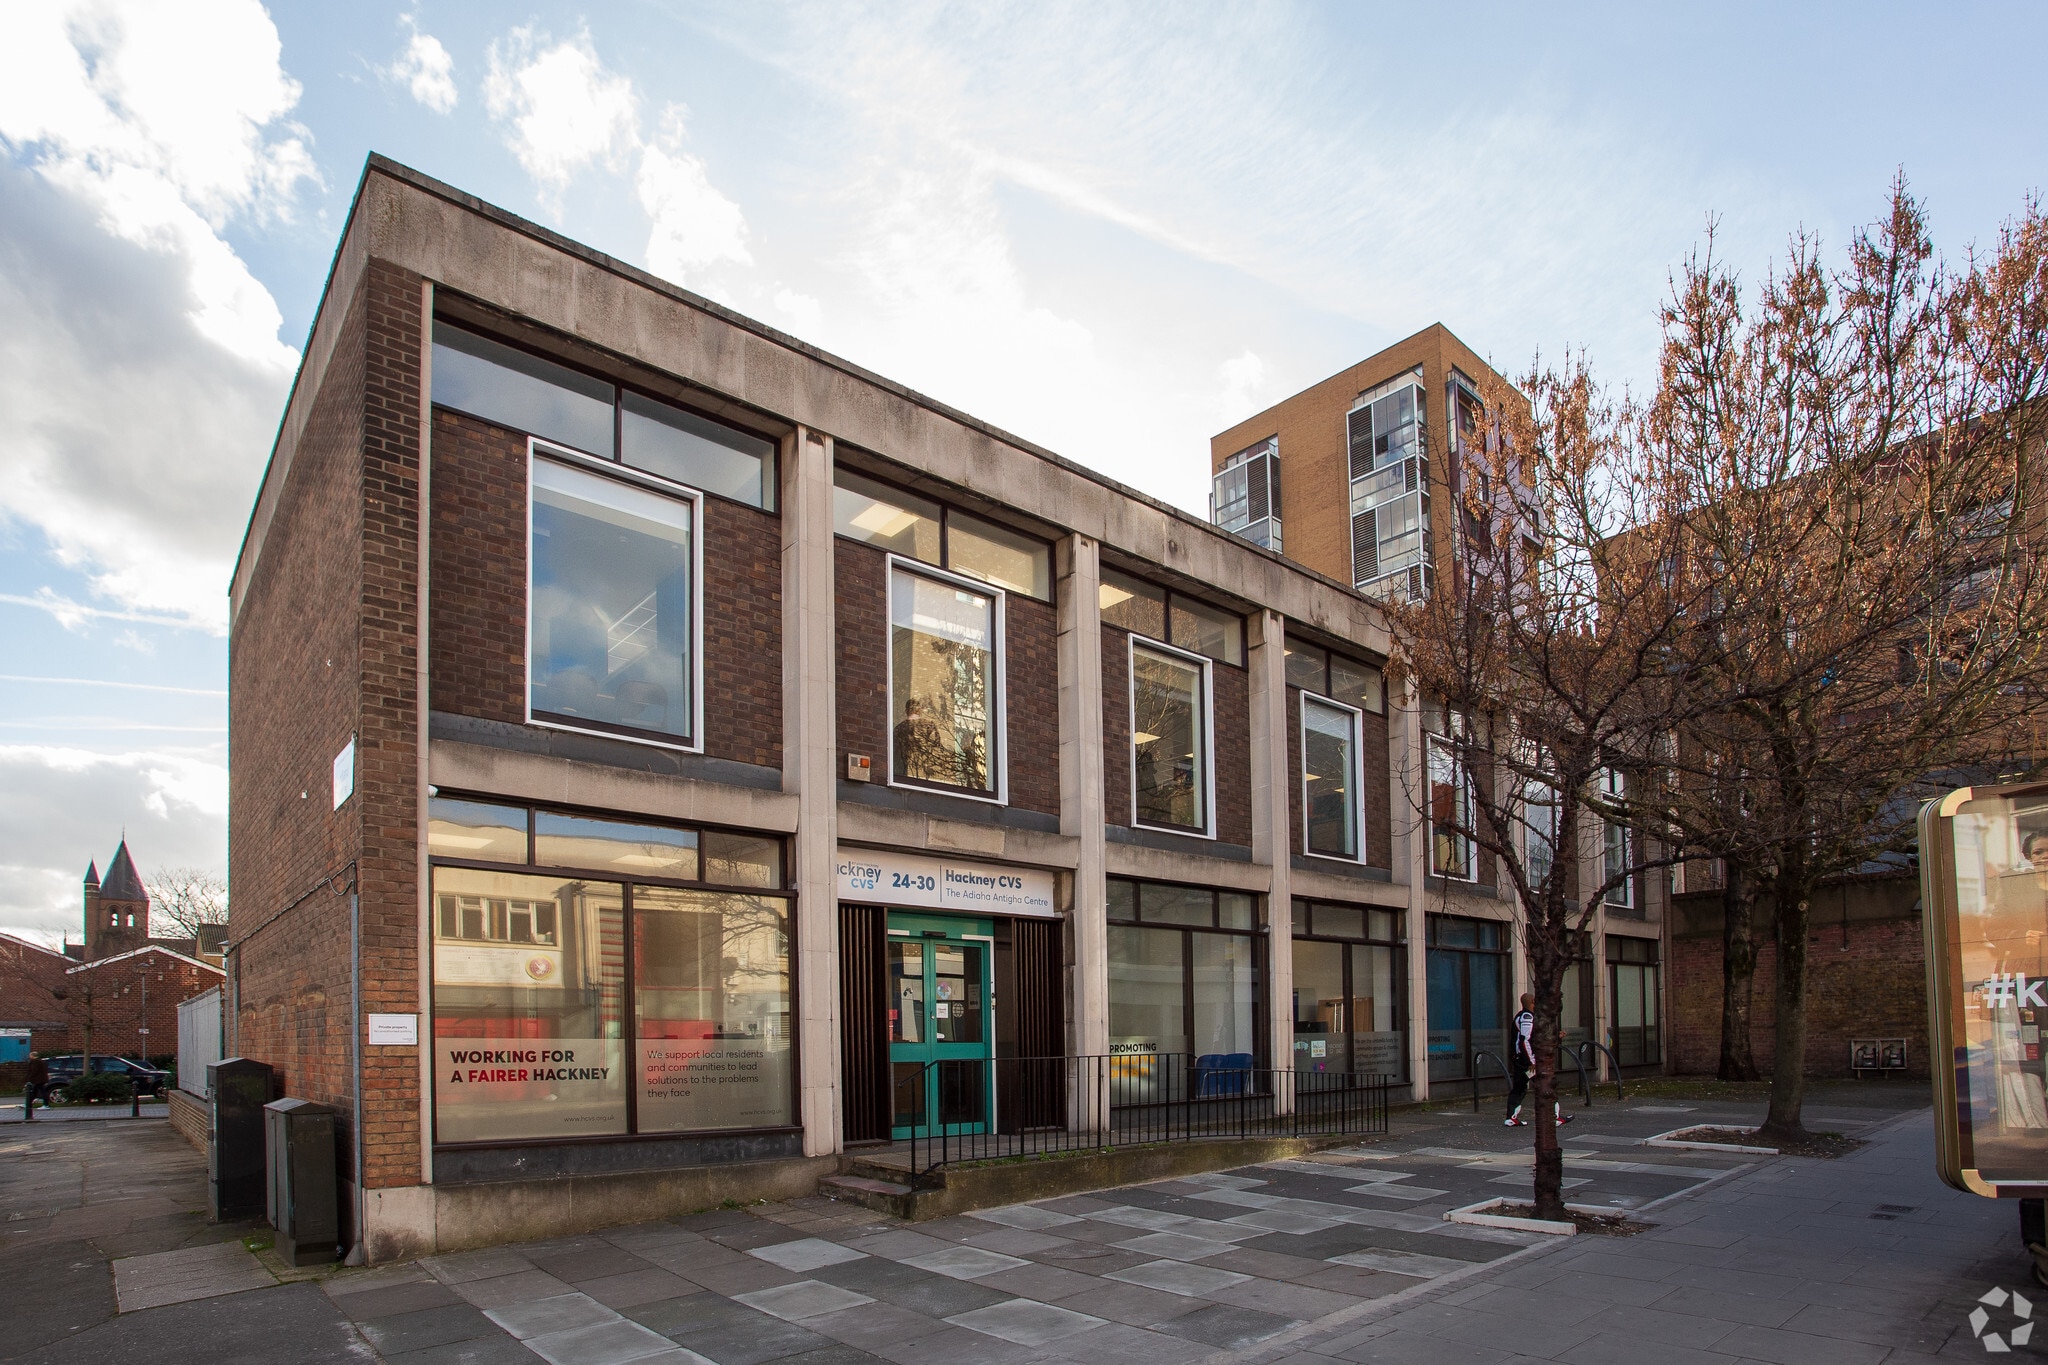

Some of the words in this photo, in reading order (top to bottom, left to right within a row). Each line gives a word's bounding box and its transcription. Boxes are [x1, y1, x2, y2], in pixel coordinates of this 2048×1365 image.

[837, 861, 881, 883] ckney
[946, 869, 995, 889] Hackney
[998, 875, 1022, 889] CVS
[892, 872, 935, 891] 24-30
[946, 888, 960, 898] The
[963, 890, 991, 901] Adiaha
[1024, 896, 1048, 906] Centre
[1982, 972, 2048, 1008] #k
[647, 1050, 663, 1059] We
[665, 1050, 700, 1060] support
[702, 1050, 724, 1058] local
[726, 1050, 764, 1058] residents
[1109, 1043, 1157, 1053] PROMOTING
[450, 1050, 537, 1064] WORKING
[541, 1050, 575, 1063] FOR
[647, 1063, 666, 1071] and
[668, 1062, 726, 1071] communities
[738, 1062, 758, 1070] lead
[450, 1070, 463, 1083] A
[468, 1069, 528, 1082] FAIRER
[533, 1067, 610, 1081] HACKNEY
[647, 1076, 688, 1085] solutions
[690, 1076, 700, 1084] to
[702, 1075, 717, 1083] the
[719, 1074, 759, 1084] problems
[647, 1089, 668, 1099] they
[670, 1088, 691, 1097] face
